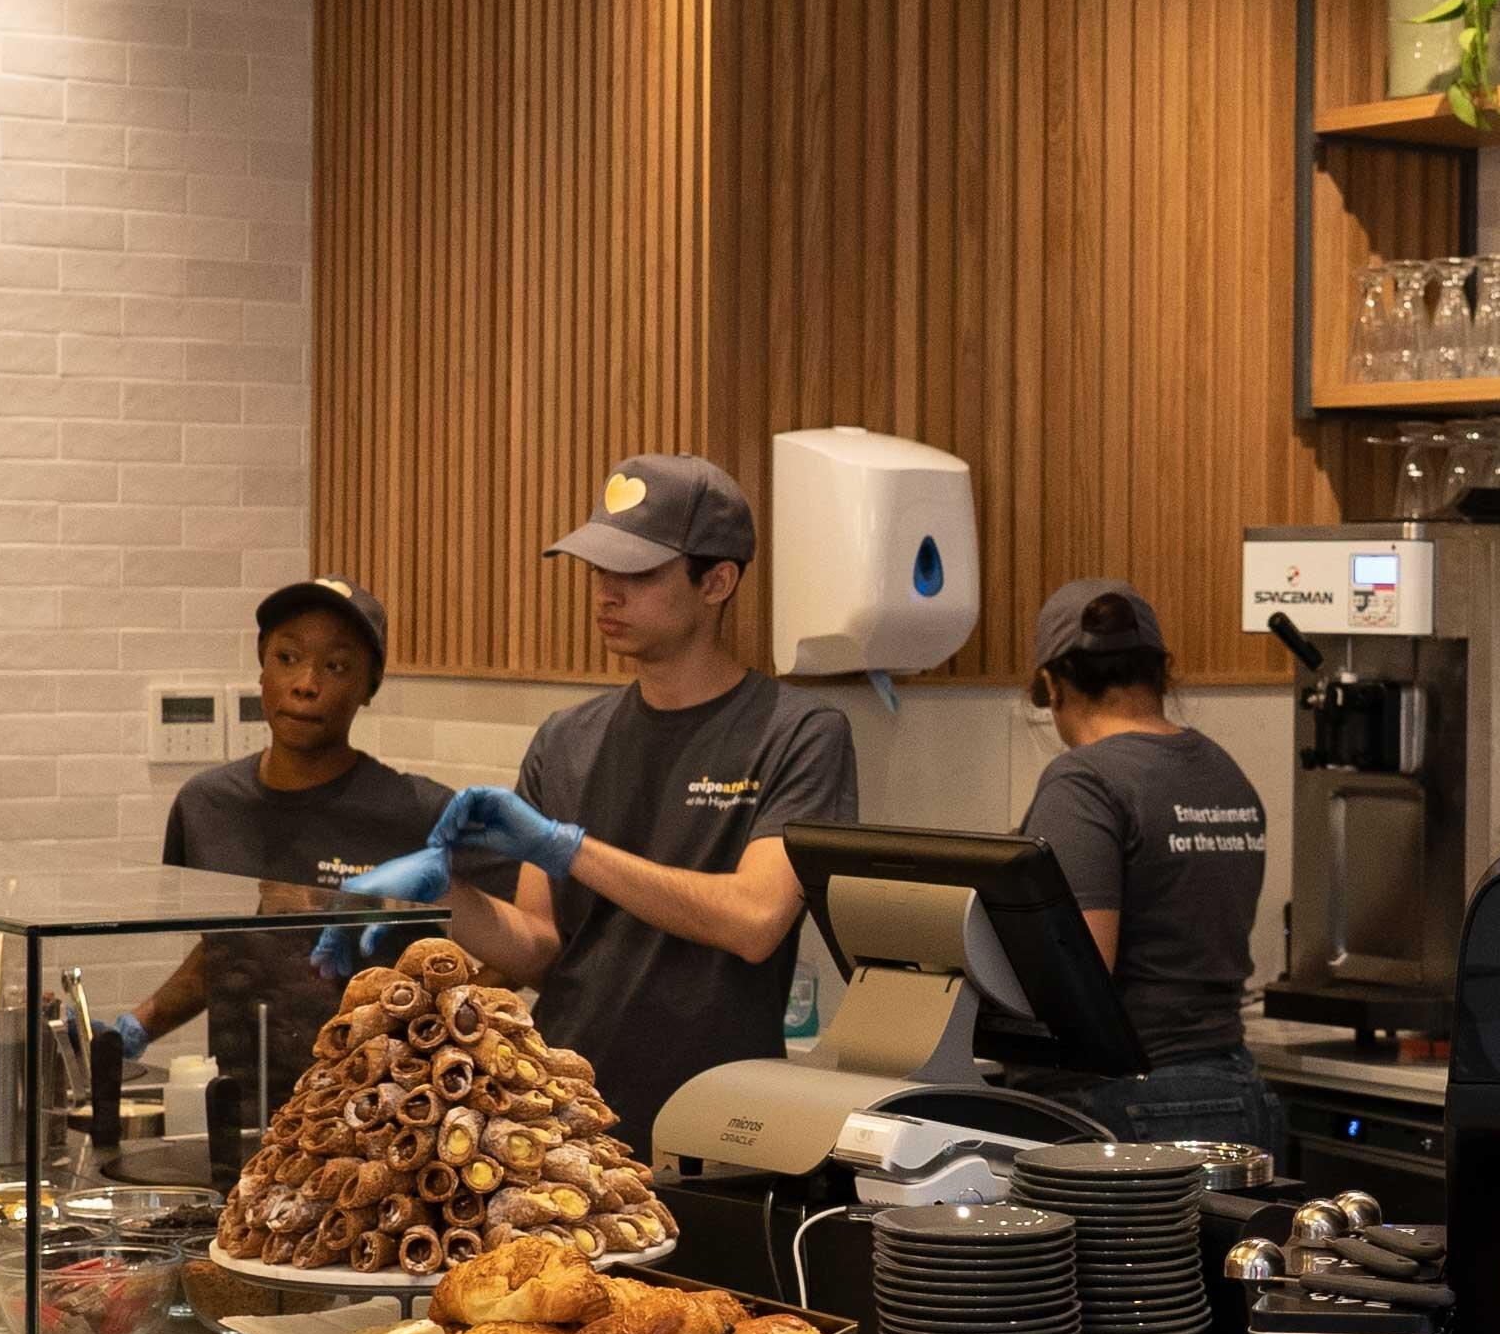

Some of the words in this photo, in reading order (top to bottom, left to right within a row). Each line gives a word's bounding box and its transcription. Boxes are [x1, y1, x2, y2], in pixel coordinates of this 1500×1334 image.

[1254, 590, 1333, 605] SPACEMAN
[1173, 804, 1259, 823] Entertainment
[1168, 833, 1192, 853] for
[1194, 832, 1216, 851] the
[1216, 834, 1245, 851] taste
[728, 1116, 764, 1132] micros
